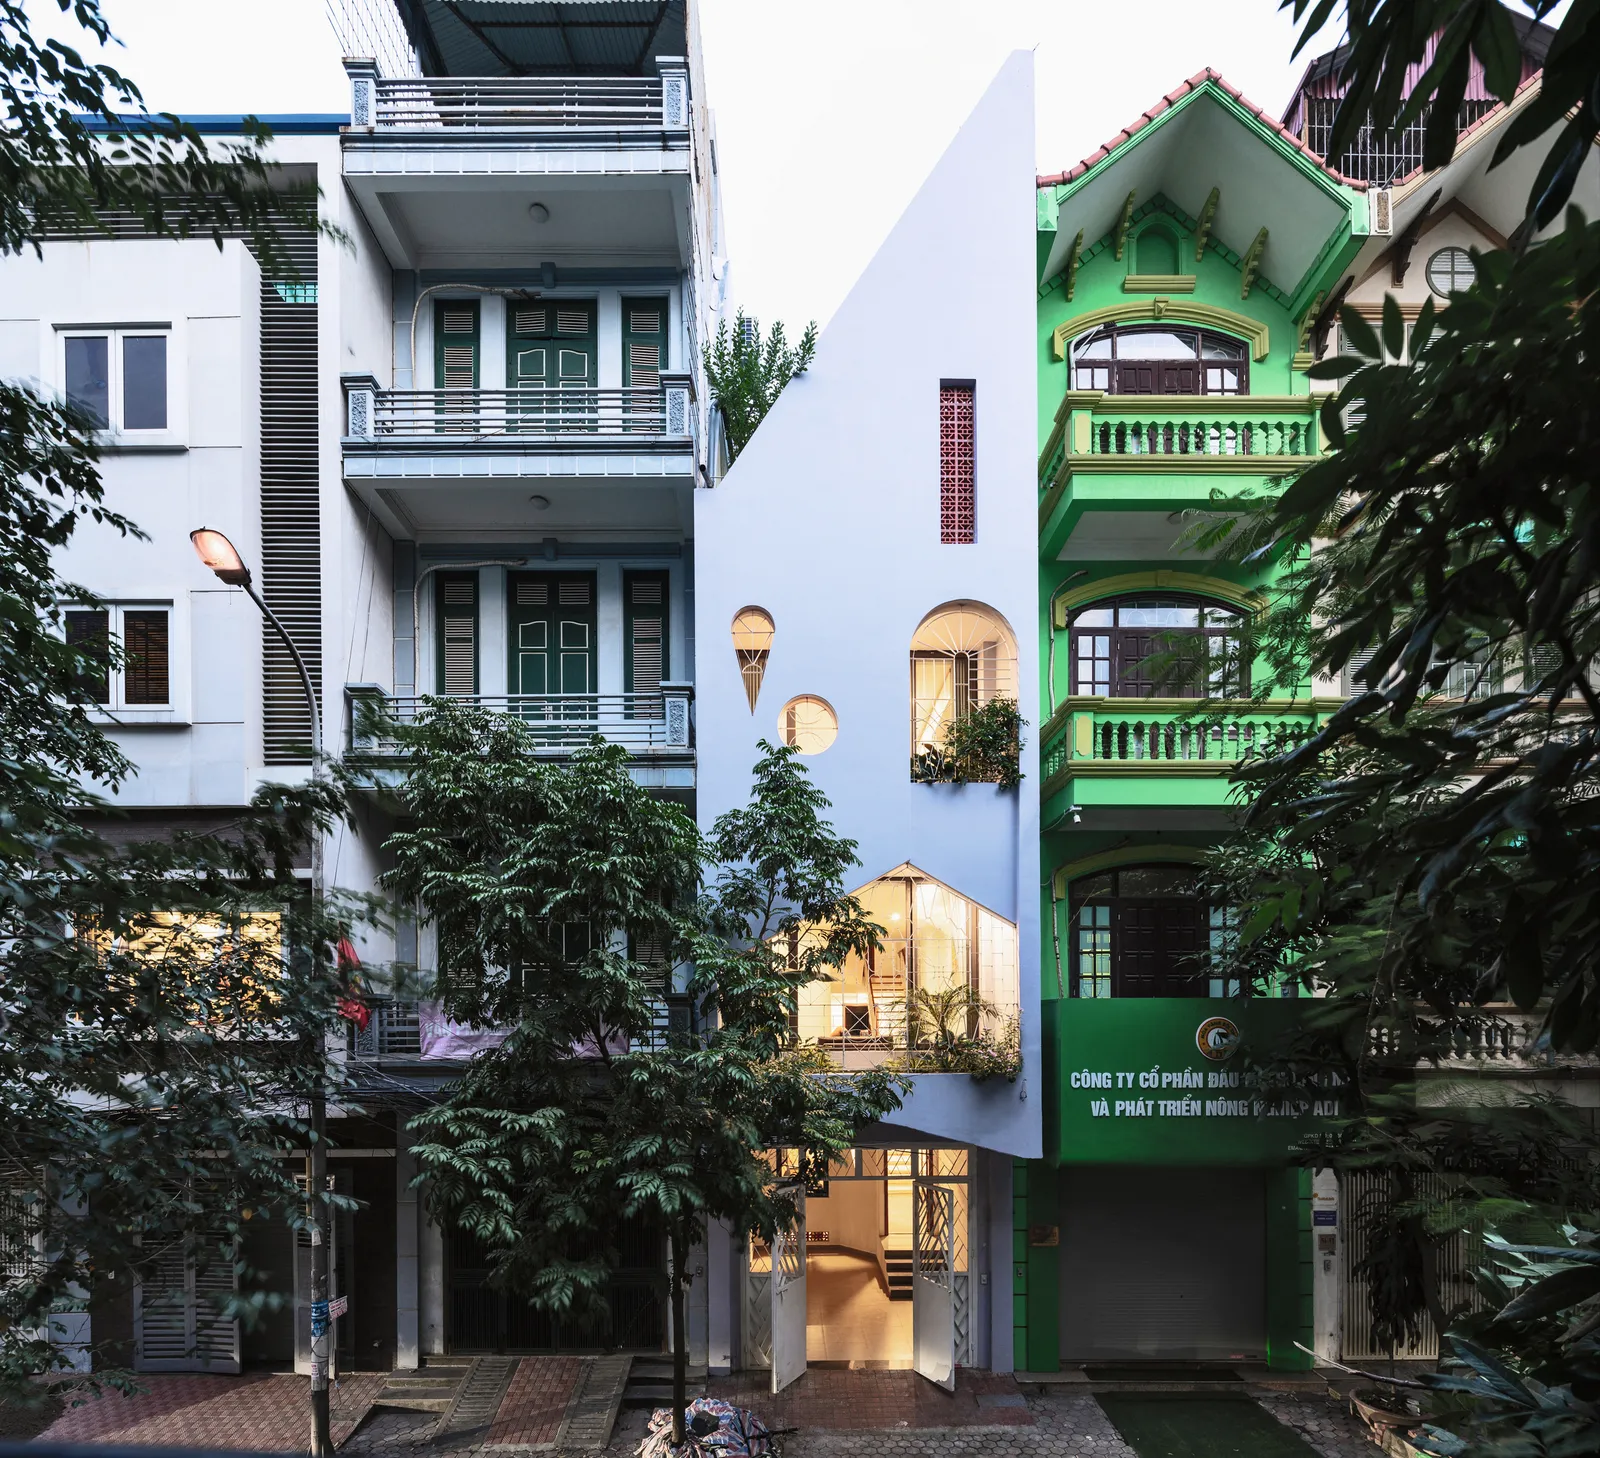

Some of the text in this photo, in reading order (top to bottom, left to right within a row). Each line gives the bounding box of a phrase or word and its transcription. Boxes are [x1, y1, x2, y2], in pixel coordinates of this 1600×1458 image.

[1070, 1069, 1112, 1089] CÔNG
[1116, 1072, 1135, 1089] TY
[1139, 1065, 1160, 1089] CỔ
[1161, 1066, 1204, 1089] PHẦN
[1090, 1097, 1111, 1117] VÀ
[1115, 1097, 1155, 1117] PHÁT
[1157, 1093, 1202, 1117] TRIỂN
[1205, 1096, 1249, 1117] NÔNG
[1312, 1100, 1339, 1117] ADI
